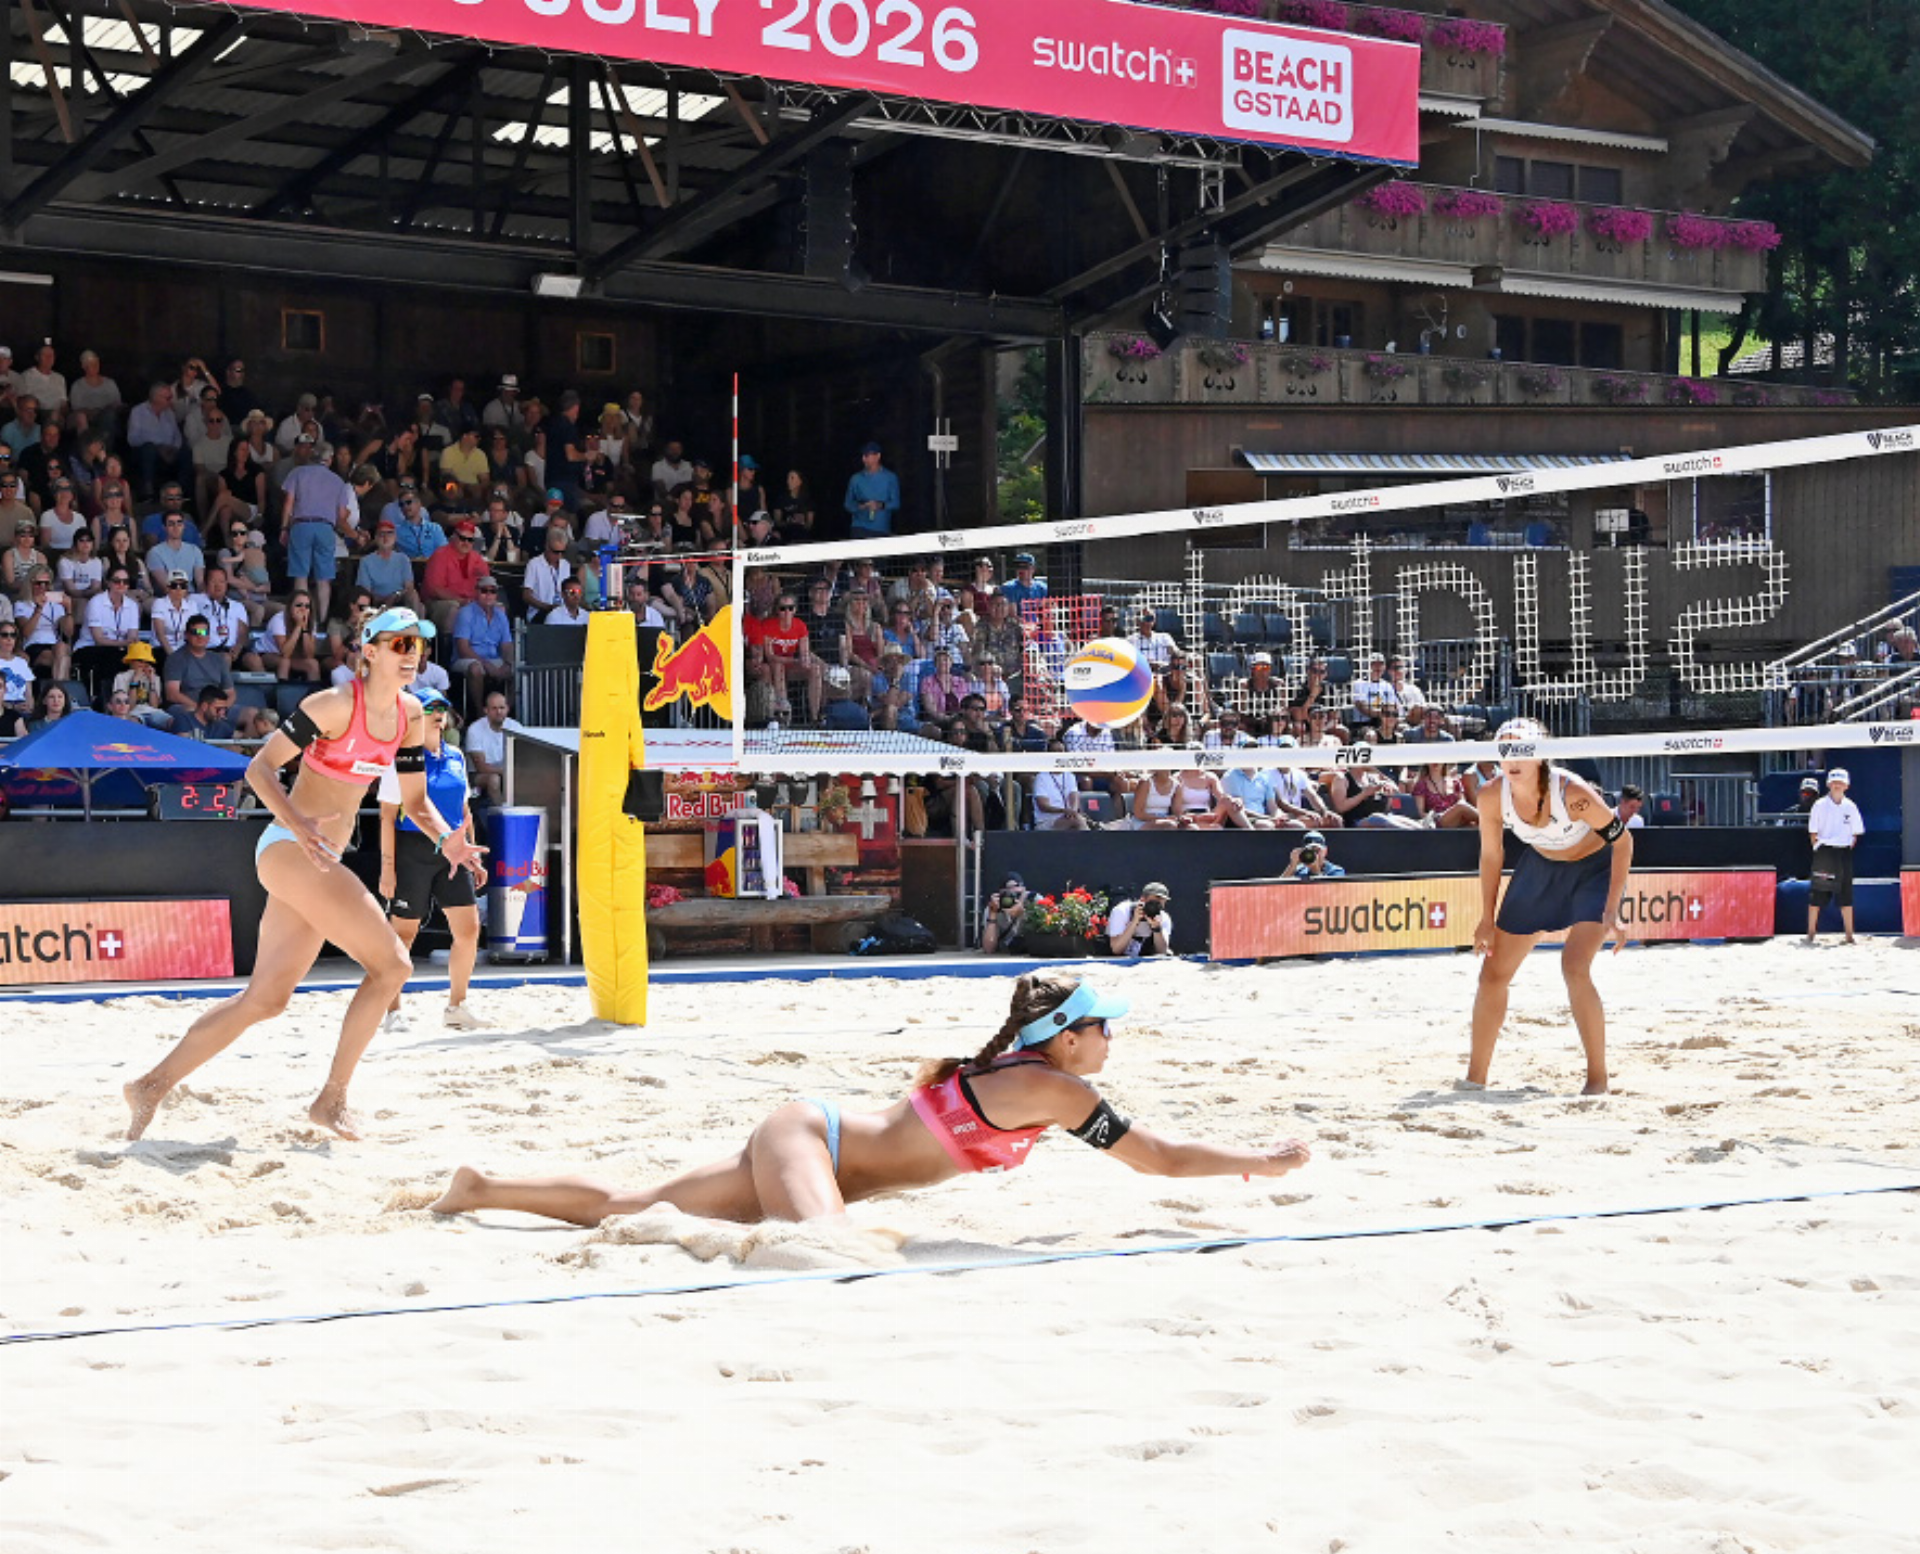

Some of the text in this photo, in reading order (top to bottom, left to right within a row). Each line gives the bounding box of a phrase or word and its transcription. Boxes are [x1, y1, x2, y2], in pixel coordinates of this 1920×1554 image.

[523, 0, 979, 73] LY 2026
[1032, 36, 1172, 86] swatch
[1232, 46, 1344, 95] BEACH
[1233, 89, 1343, 125] GSTAAD
[1663, 456, 1712, 473] swatch
[1335, 748, 1372, 764] FIVB
[669, 792, 706, 818] Red
[496, 860, 528, 877] Red
[1304, 896, 1424, 935] swatch
